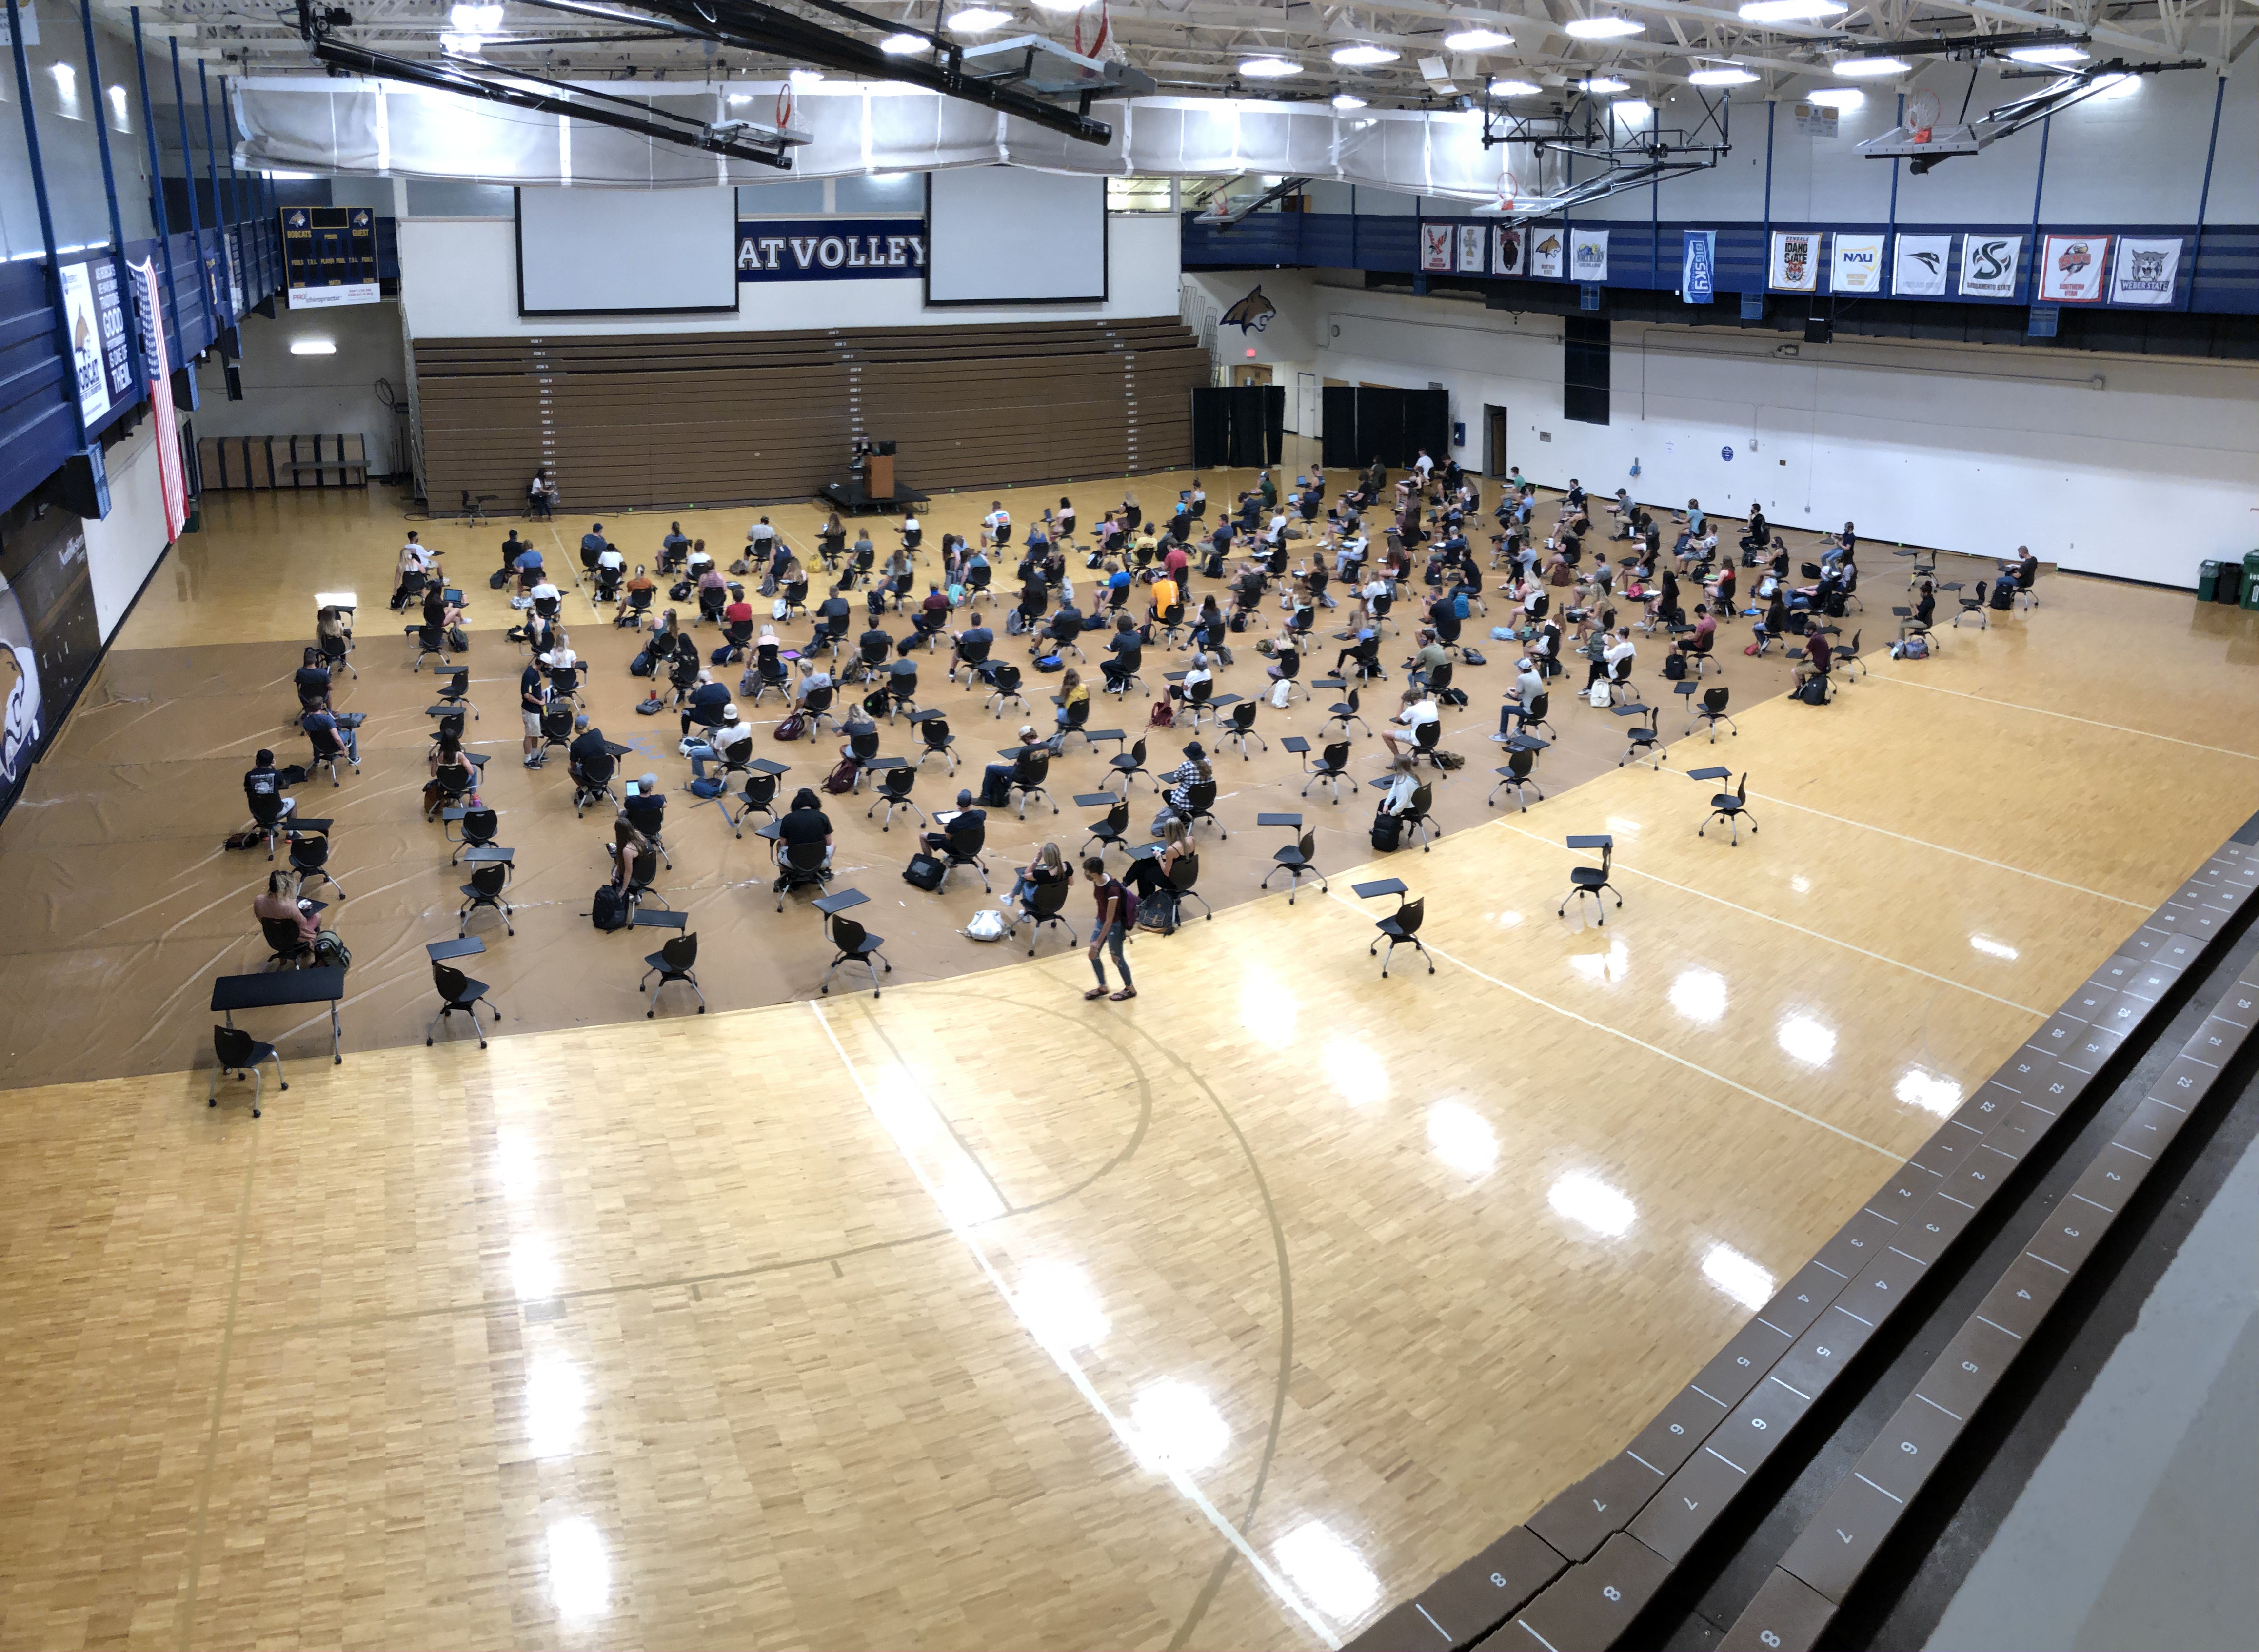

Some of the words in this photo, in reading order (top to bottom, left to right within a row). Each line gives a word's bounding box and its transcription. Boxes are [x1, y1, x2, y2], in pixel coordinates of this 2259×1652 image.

[287, 230, 312, 238] BOBCATS
[738, 237, 786, 270] AT
[788, 235, 926, 269] VOLLEY
[1695, 243, 1704, 262] BIG
[1785, 243, 1808, 253] IDAHO
[1784, 253, 1807, 264] STATE
[1843, 253, 1873, 263] NAU
[1695, 262, 1708, 290] SKY
[1967, 282, 1996, 290] SACRAMENTO
[2122, 281, 2146, 289] WEBER
[2146, 281, 2168, 290] STATE
[103, 306, 124, 338] GOOD
[2237, 999, 2252, 1009] 20
[2118, 1008, 2131, 1017] 20
[2052, 1028, 2065, 1038] 20
[2208, 1036, 2222, 1046] 21
[2085, 1043, 2100, 1053] 21
[2017, 1064, 2031, 1073] 21
[2176, 1076, 2193, 1088] 22
[2049, 1082, 2065, 1094] 22
[1980, 1101, 1995, 1112] 22
[1972, 1171, 1985, 1180] 2
[2105, 1171, 2120, 1180] 2
[1898, 1188, 1911, 1197] 2
[1926, 1224, 1940, 1232] 3
[2064, 1227, 2080, 1237] 3
[1851, 1239, 1863, 1247] 3
[1874, 1280, 1888, 1290] 4
[1797, 1294, 1810, 1303] 4
[2016, 1289, 2031, 1299] 4
[1816, 1346, 1831, 1357] 5
[1737, 1357, 1751, 1367] 5
[1962, 1361, 1979, 1373] 5
[1751, 1418, 1767, 1430] 6
[1670, 1424, 1684, 1435] 6
[1900, 1442, 1918, 1455] 6
[1592, 1499, 1607, 1512] 7
[1683, 1497, 1699, 1510] 7
[1836, 1528, 1853, 1544] 7
[1490, 1573, 1506, 1587] 8
[1603, 1586, 1621, 1601] 8
[1761, 1630, 1781, 1648] 8
